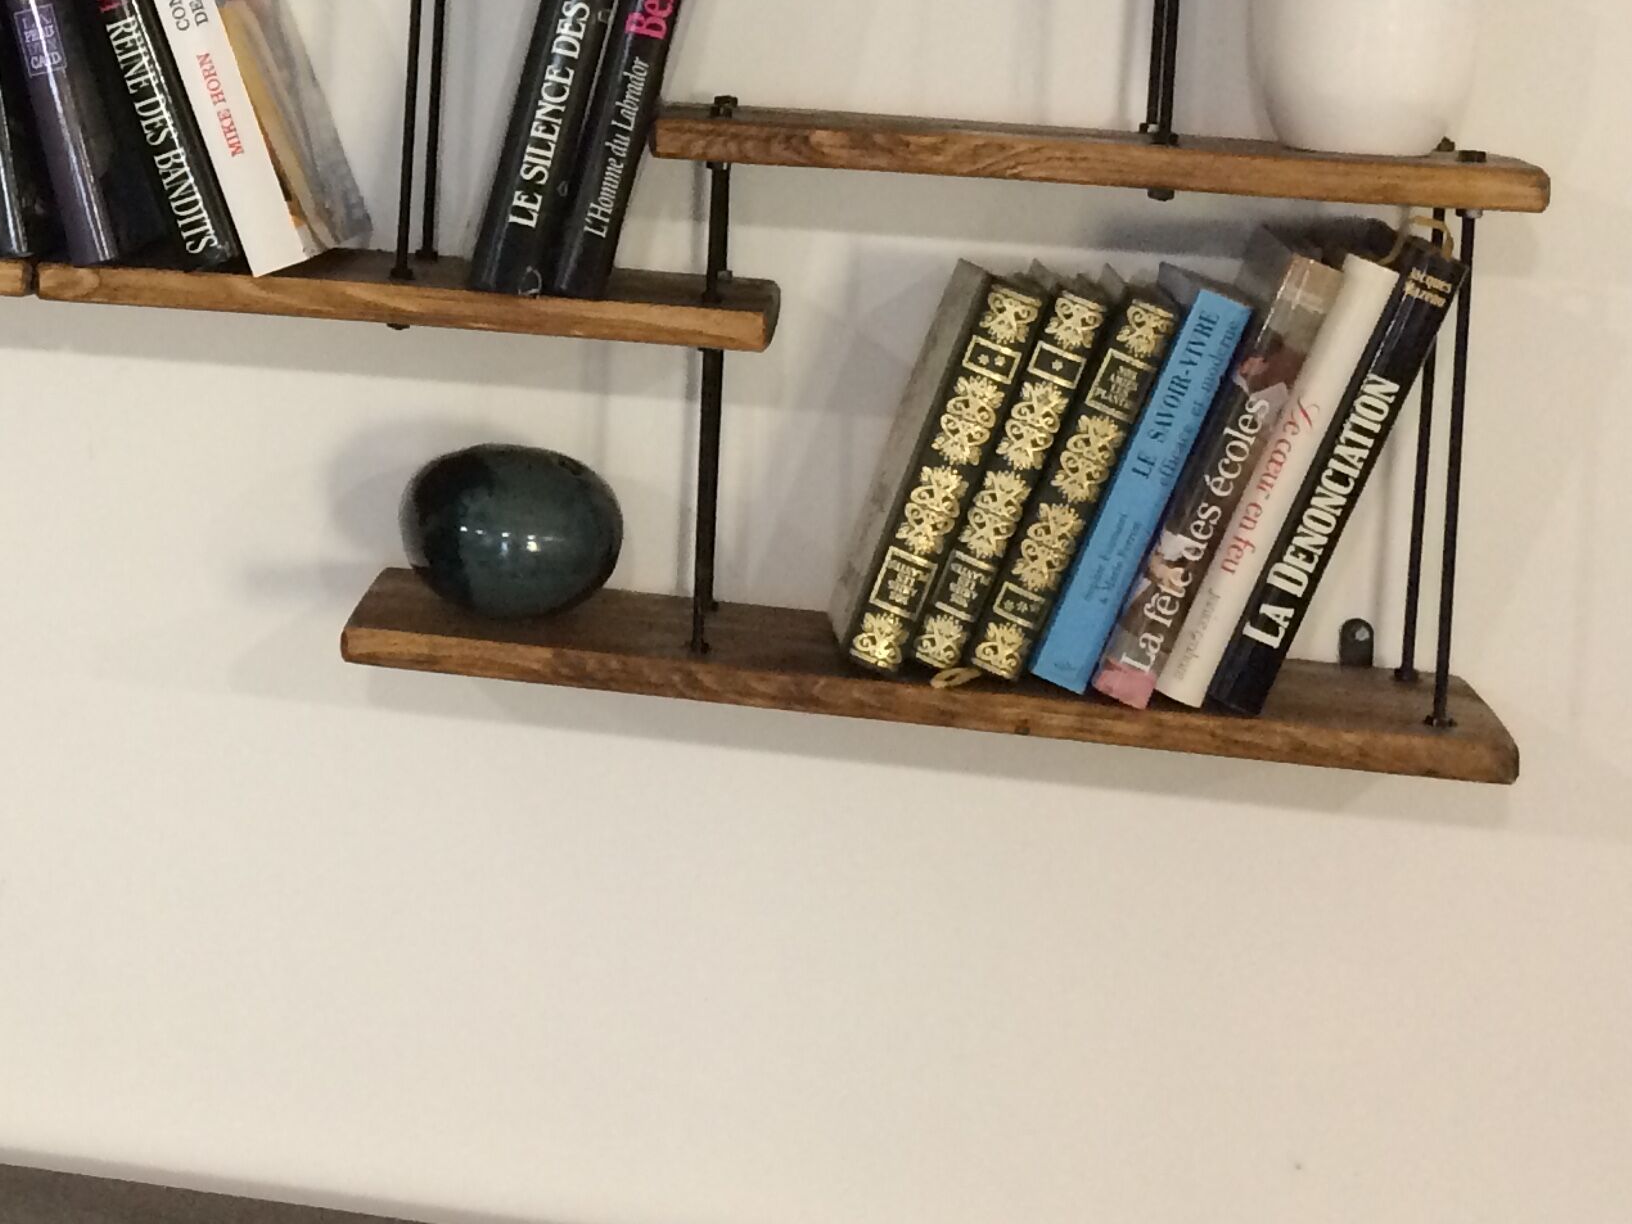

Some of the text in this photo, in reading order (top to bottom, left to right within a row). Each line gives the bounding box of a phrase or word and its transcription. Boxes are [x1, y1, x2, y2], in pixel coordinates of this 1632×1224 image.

[106, 14, 160, 94] REINE
[196, 52, 245, 157] MIKE HORN
[134, 91, 179, 146] DES
[519, 63, 575, 185] SILENCE
[583, 56, 650, 238] L'Homme du Labrador
[153, 144, 221, 254] BANDITS
[507, 189, 543, 228] LE
[1131, 314, 1220, 479] LE SAVOIR-VIVRE
[1189, 399, 1203, 417] et
[1200, 320, 1240, 394] moderne
[1119, 389, 1273, 675] La fête des écoles
[1218, 394, 1321, 576] Le cœur en feu
[1242, 321, 1402, 649] LA DENONCIATION
